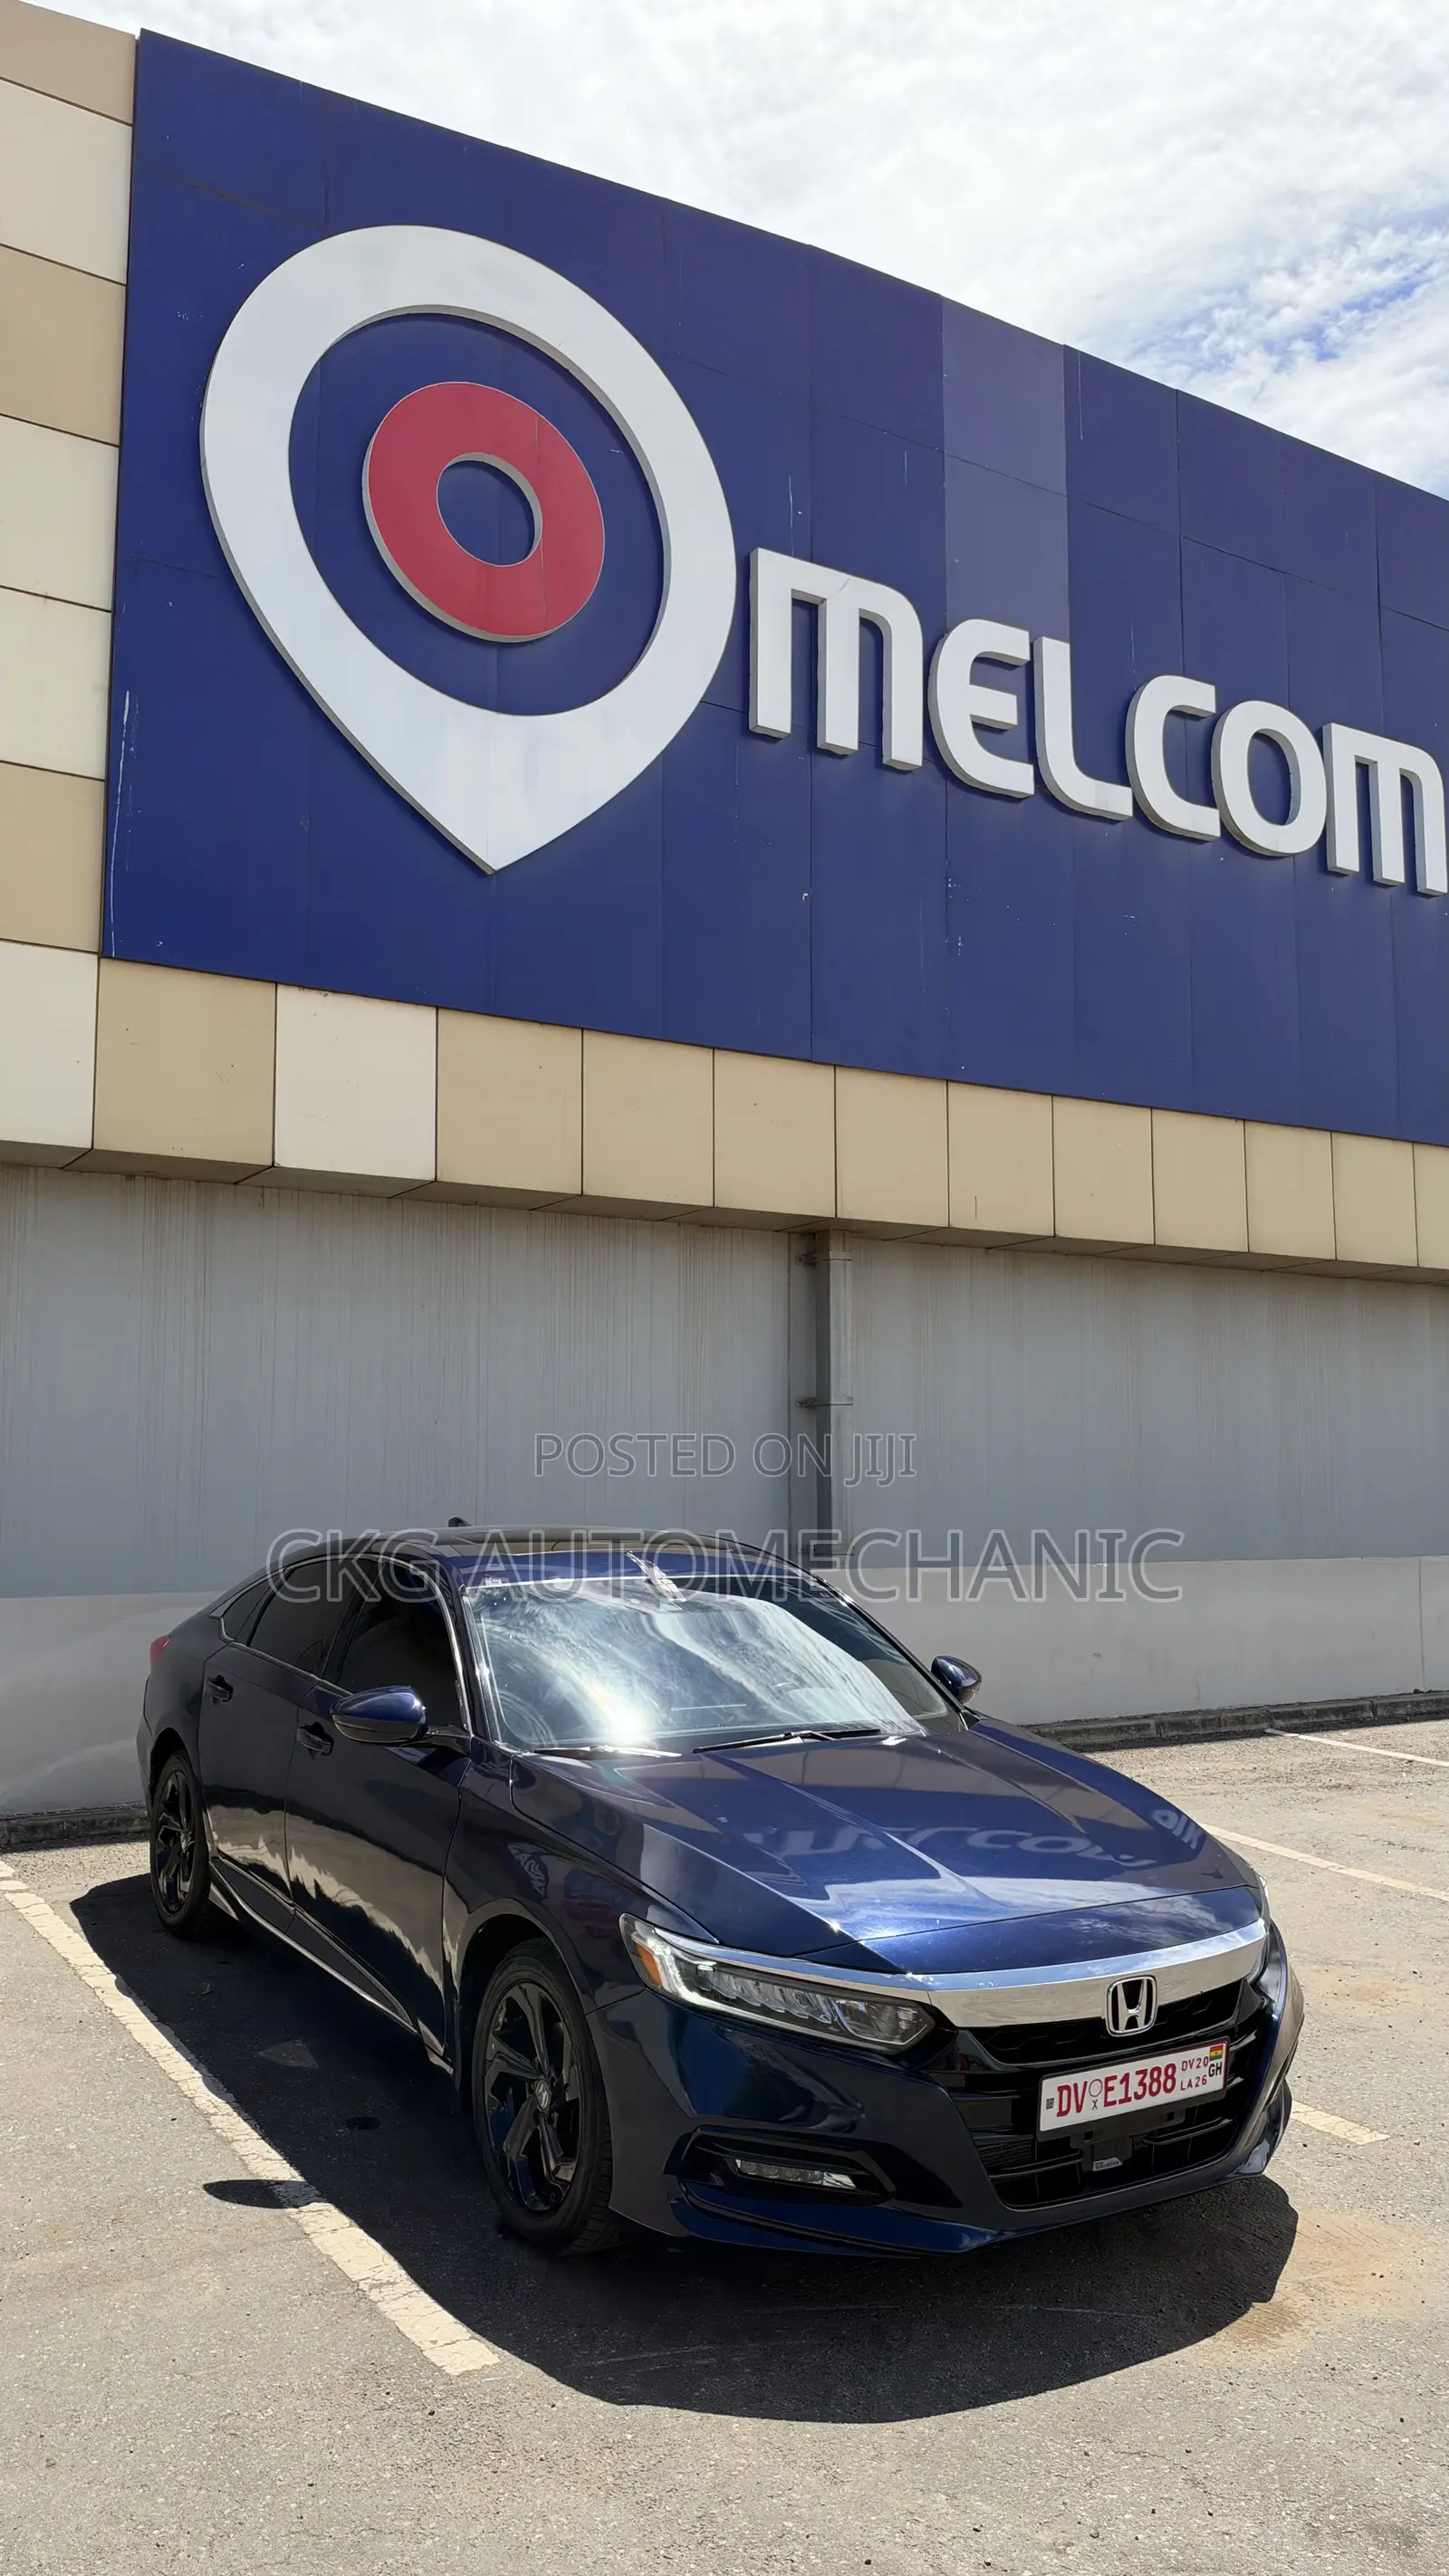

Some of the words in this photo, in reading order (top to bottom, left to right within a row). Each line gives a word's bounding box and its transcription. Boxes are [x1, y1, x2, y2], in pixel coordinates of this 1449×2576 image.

[749, 547, 1448, 896] MELCOM
[1181, 2056, 1209, 2072] DV20
[1208, 2061, 1223, 2077] GH
[1057, 2081, 1088, 2117] DV
[1104, 2064, 1176, 2107] E1388
[1180, 2074, 1207, 2091] LA26
